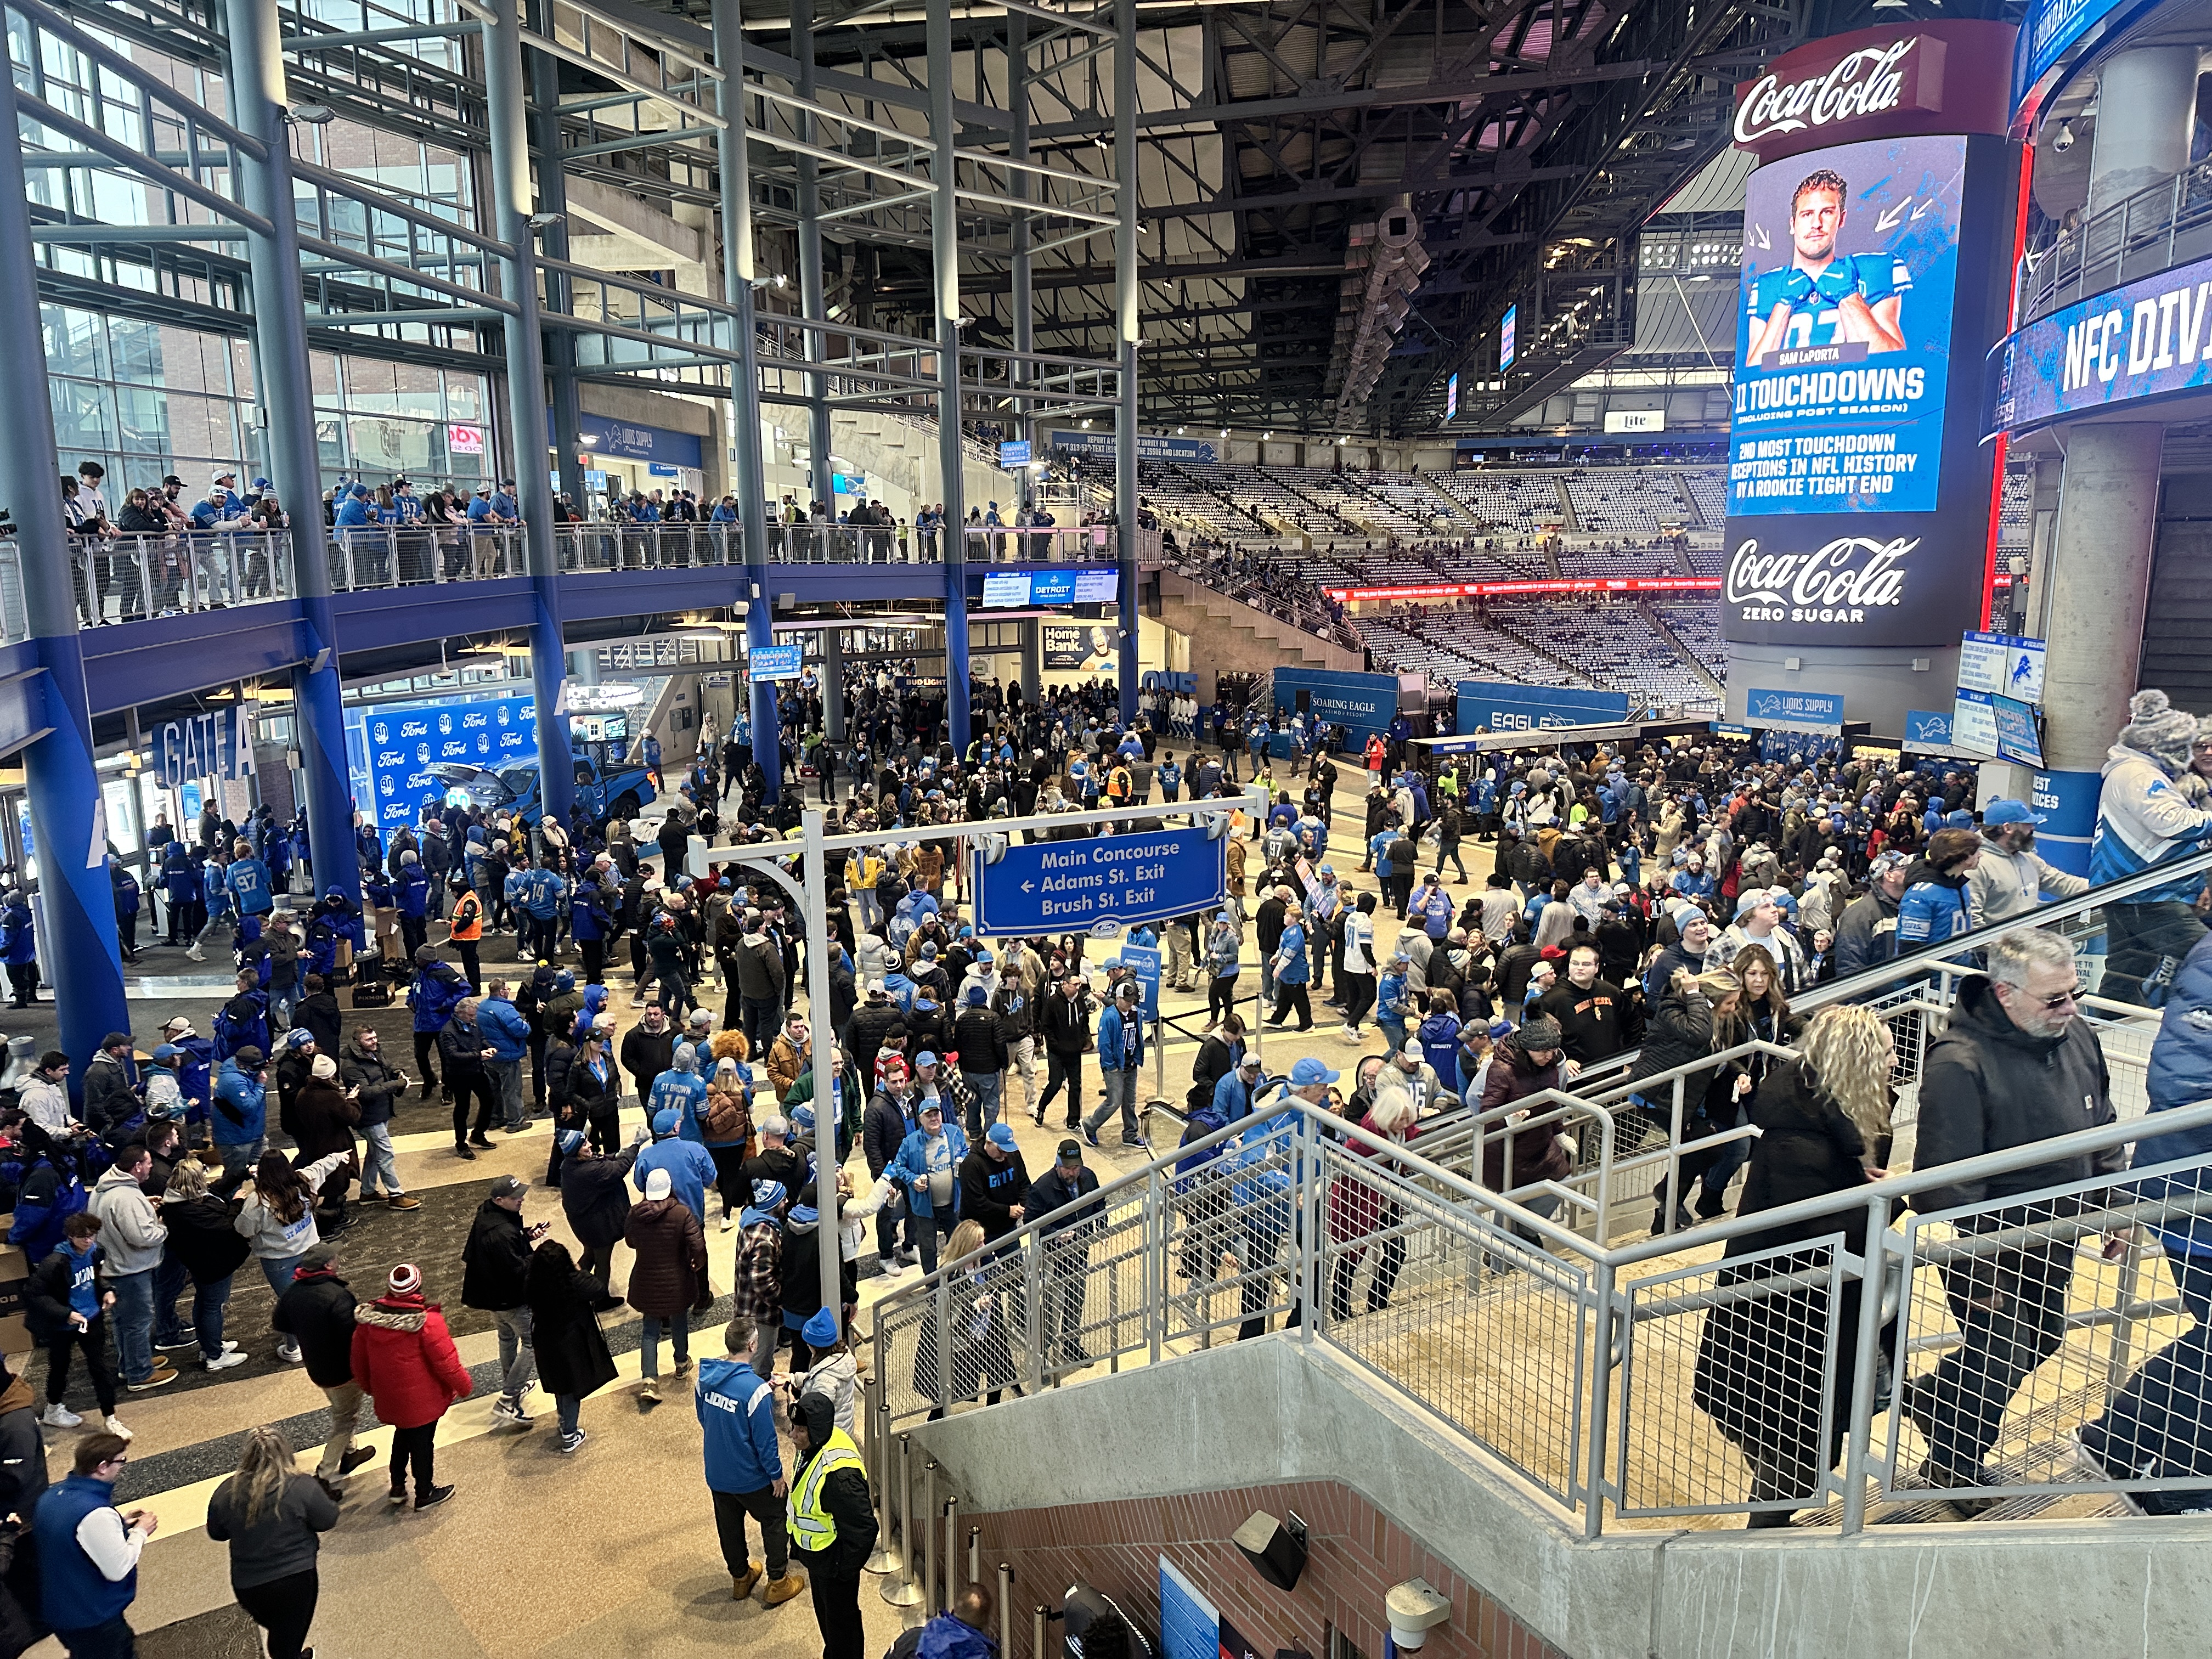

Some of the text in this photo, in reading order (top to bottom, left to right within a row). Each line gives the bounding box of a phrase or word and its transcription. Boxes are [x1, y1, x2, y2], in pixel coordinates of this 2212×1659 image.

[1735, 37, 1916, 142] Coca-Cola
[1779, 352, 1798, 365] SAM
[2063, 309, 2122, 392] NFC
[1735, 367, 1925, 414] 11 TOUCHDOWNS
[1592, 415, 1613, 428] Lite
[1738, 403, 1908, 425] (INCLUDING POST SEASON)
[622, 427, 652, 448] LIONS SUPPLY
[1147, 448, 1161, 456] ISSUE
[1173, 449, 1196, 458] LOCATION
[1740, 434, 1895, 460] 2ND MOST TOUCHDOWN
[1731, 454, 1917, 479] RECEPTIONS IN NFL HISTORY
[1737, 475, 1893, 498] BY A ROOKIE TIGHT END
[1728, 537, 1921, 606] Coca-Cola
[1742, 608, 1864, 623] ZERO SUGAR
[1045, 628, 1080, 639] Home
[1046, 639, 1084, 652] Bank.
[1142, 670, 1198, 697] ONE
[519, 706, 535, 720] For
[1313, 697, 1375, 713] SOARING EAGLE
[1783, 697, 1833, 713] LIONS SUPPLY
[400, 721, 427, 737] Ford
[463, 713, 487, 728] Ford
[1491, 712, 1551, 730] EAGLE
[164, 704, 256, 789] GATE A
[499, 732, 522, 747] Ford
[442, 741, 466, 757] Ford
[377, 751, 405, 768] Ford
[407, 773, 432, 789] Ford
[384, 803, 411, 820] Ford
[1041, 843, 1180, 870] Main Concourse
[1269, 840, 1282, 857] 97
[237, 872, 257, 893] 97
[1041, 864, 1164, 893] Adams St. Exit
[532, 883, 544, 903] 14
[1042, 887, 1154, 916] Brush St. Exit
[1650, 899, 1665, 918] 11
[661, 1082, 691, 1094] ST BROWN
[1407, 1082, 1427, 1108] 16
[286, 1231, 294, 1240] ST
[704, 1391, 738, 1414] LIONS
